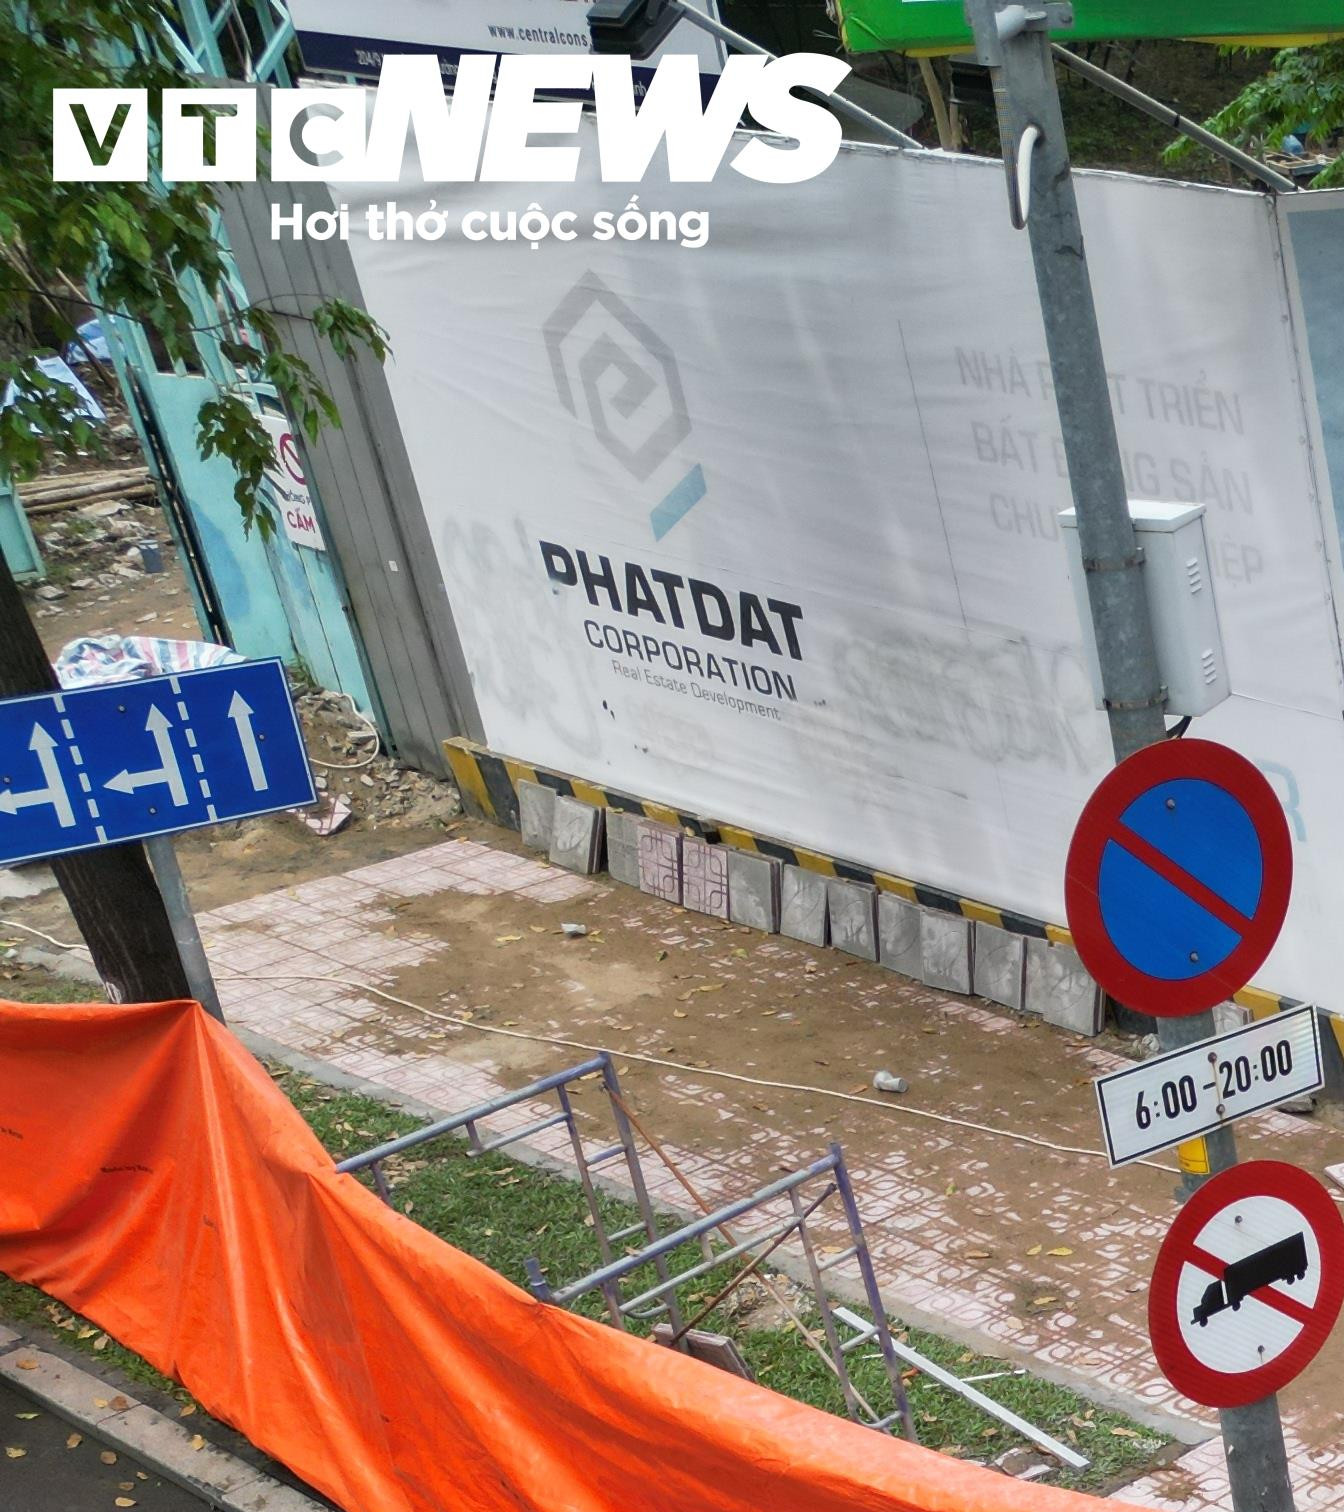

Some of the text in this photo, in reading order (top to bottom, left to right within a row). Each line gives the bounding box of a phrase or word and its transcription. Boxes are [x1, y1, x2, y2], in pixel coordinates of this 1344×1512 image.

[955, 347, 1245, 436] NHÀ PT TRIỂN
[971, 415, 1038, 474] BẤT
[1170, 450, 1254, 516] SẢN
[538, 540, 804, 661] PHATDAT
[583, 619, 799, 702] CORPORATION
[612, 659, 782, 722] Real Estate Development
